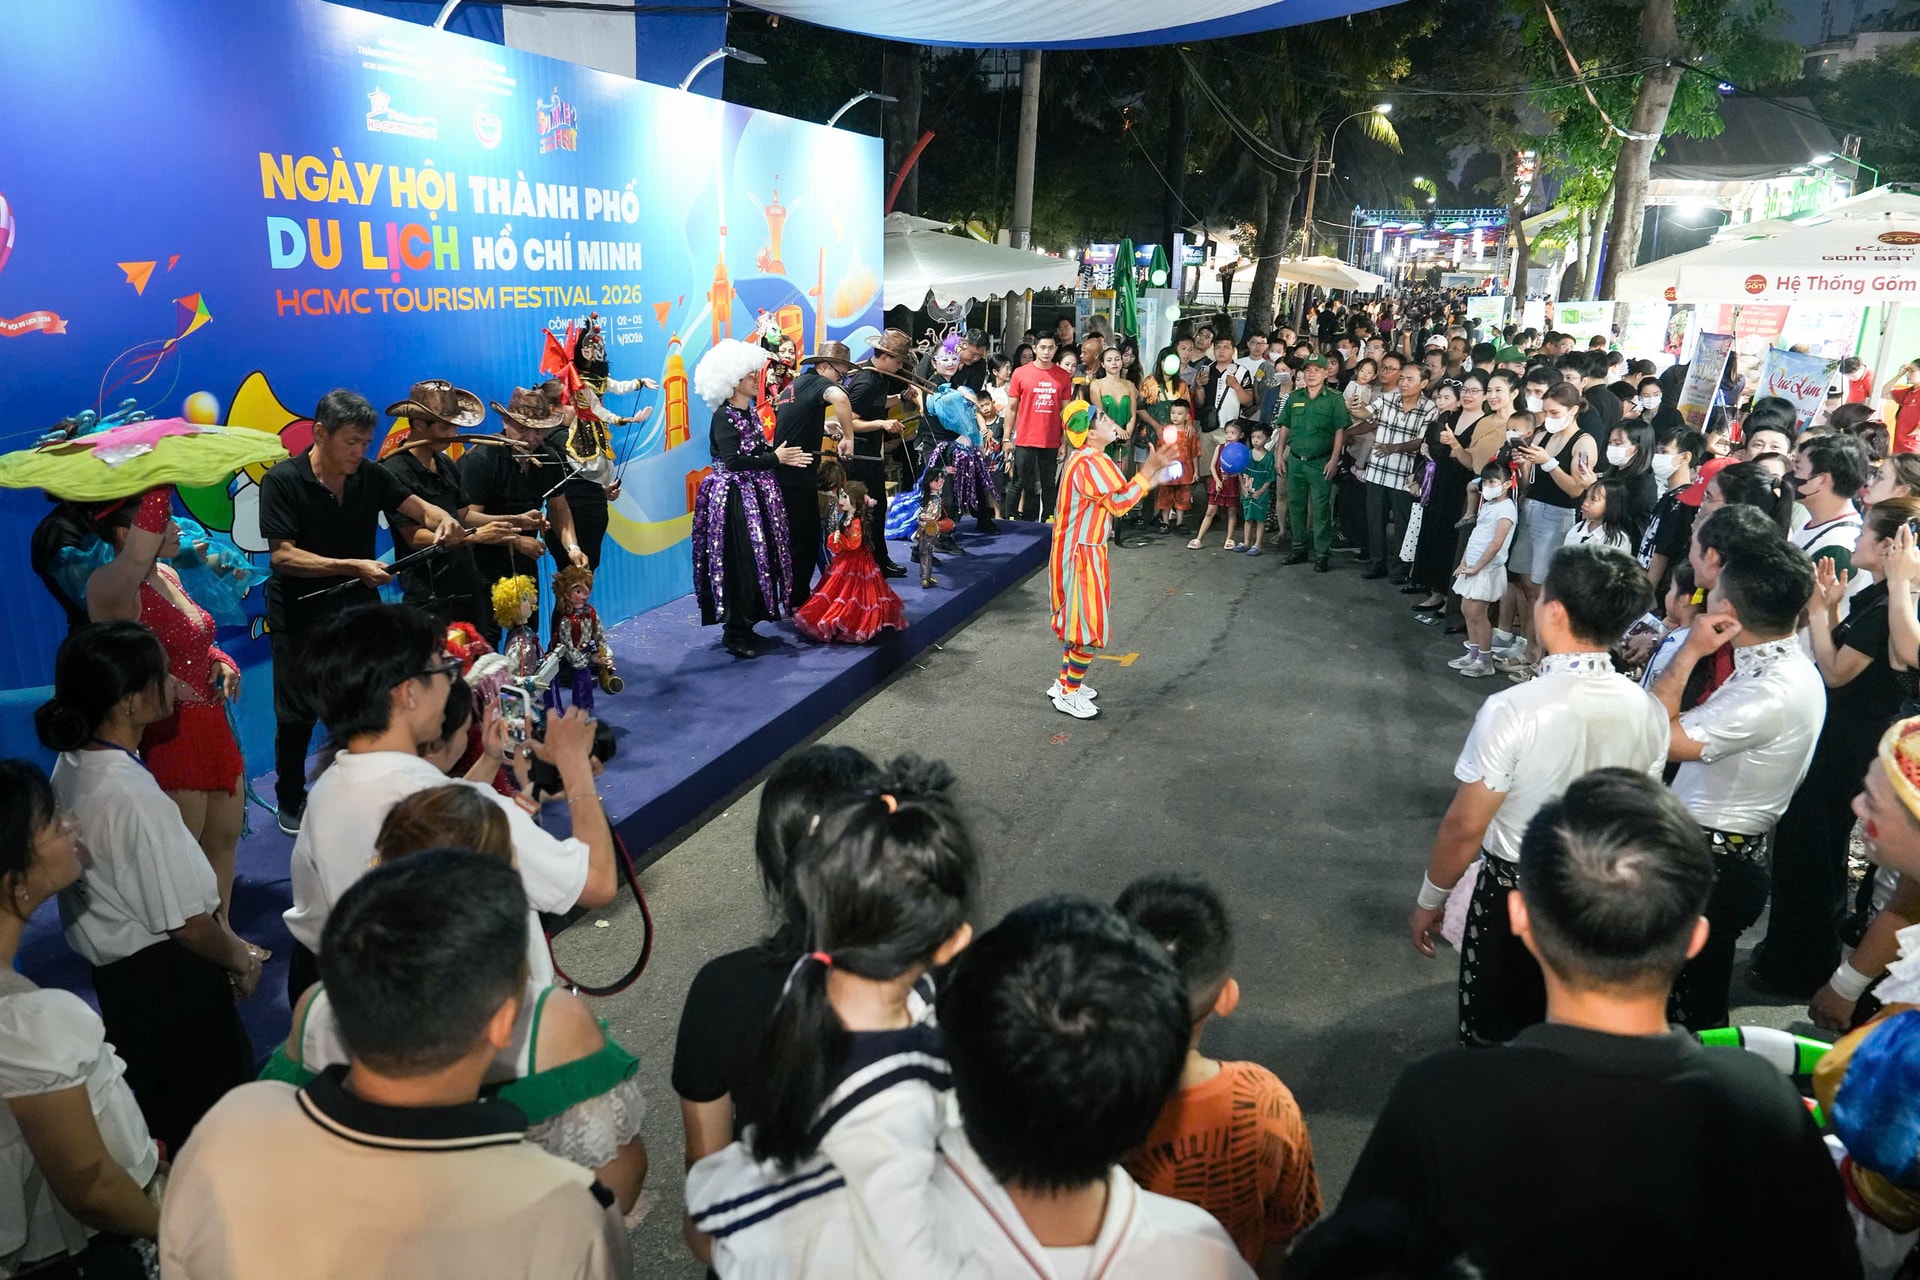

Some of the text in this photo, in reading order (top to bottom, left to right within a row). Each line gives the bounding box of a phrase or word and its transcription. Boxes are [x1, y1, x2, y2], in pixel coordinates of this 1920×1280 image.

[555, 128, 577, 151] FEST
[259, 147, 458, 221] NGÀY HỘI
[468, 170, 640, 224] THÀNH PHỐ
[266, 216, 460, 284] DU LỊCH
[472, 223, 642, 271] HỒ CHÍ MINH
[276, 285, 642, 317] HCMC TOURISM FESTIVAL 2026
[1777, 275, 1916, 294] Hệ Thống Gốm
[617, 333, 643, 346] 4/2026
